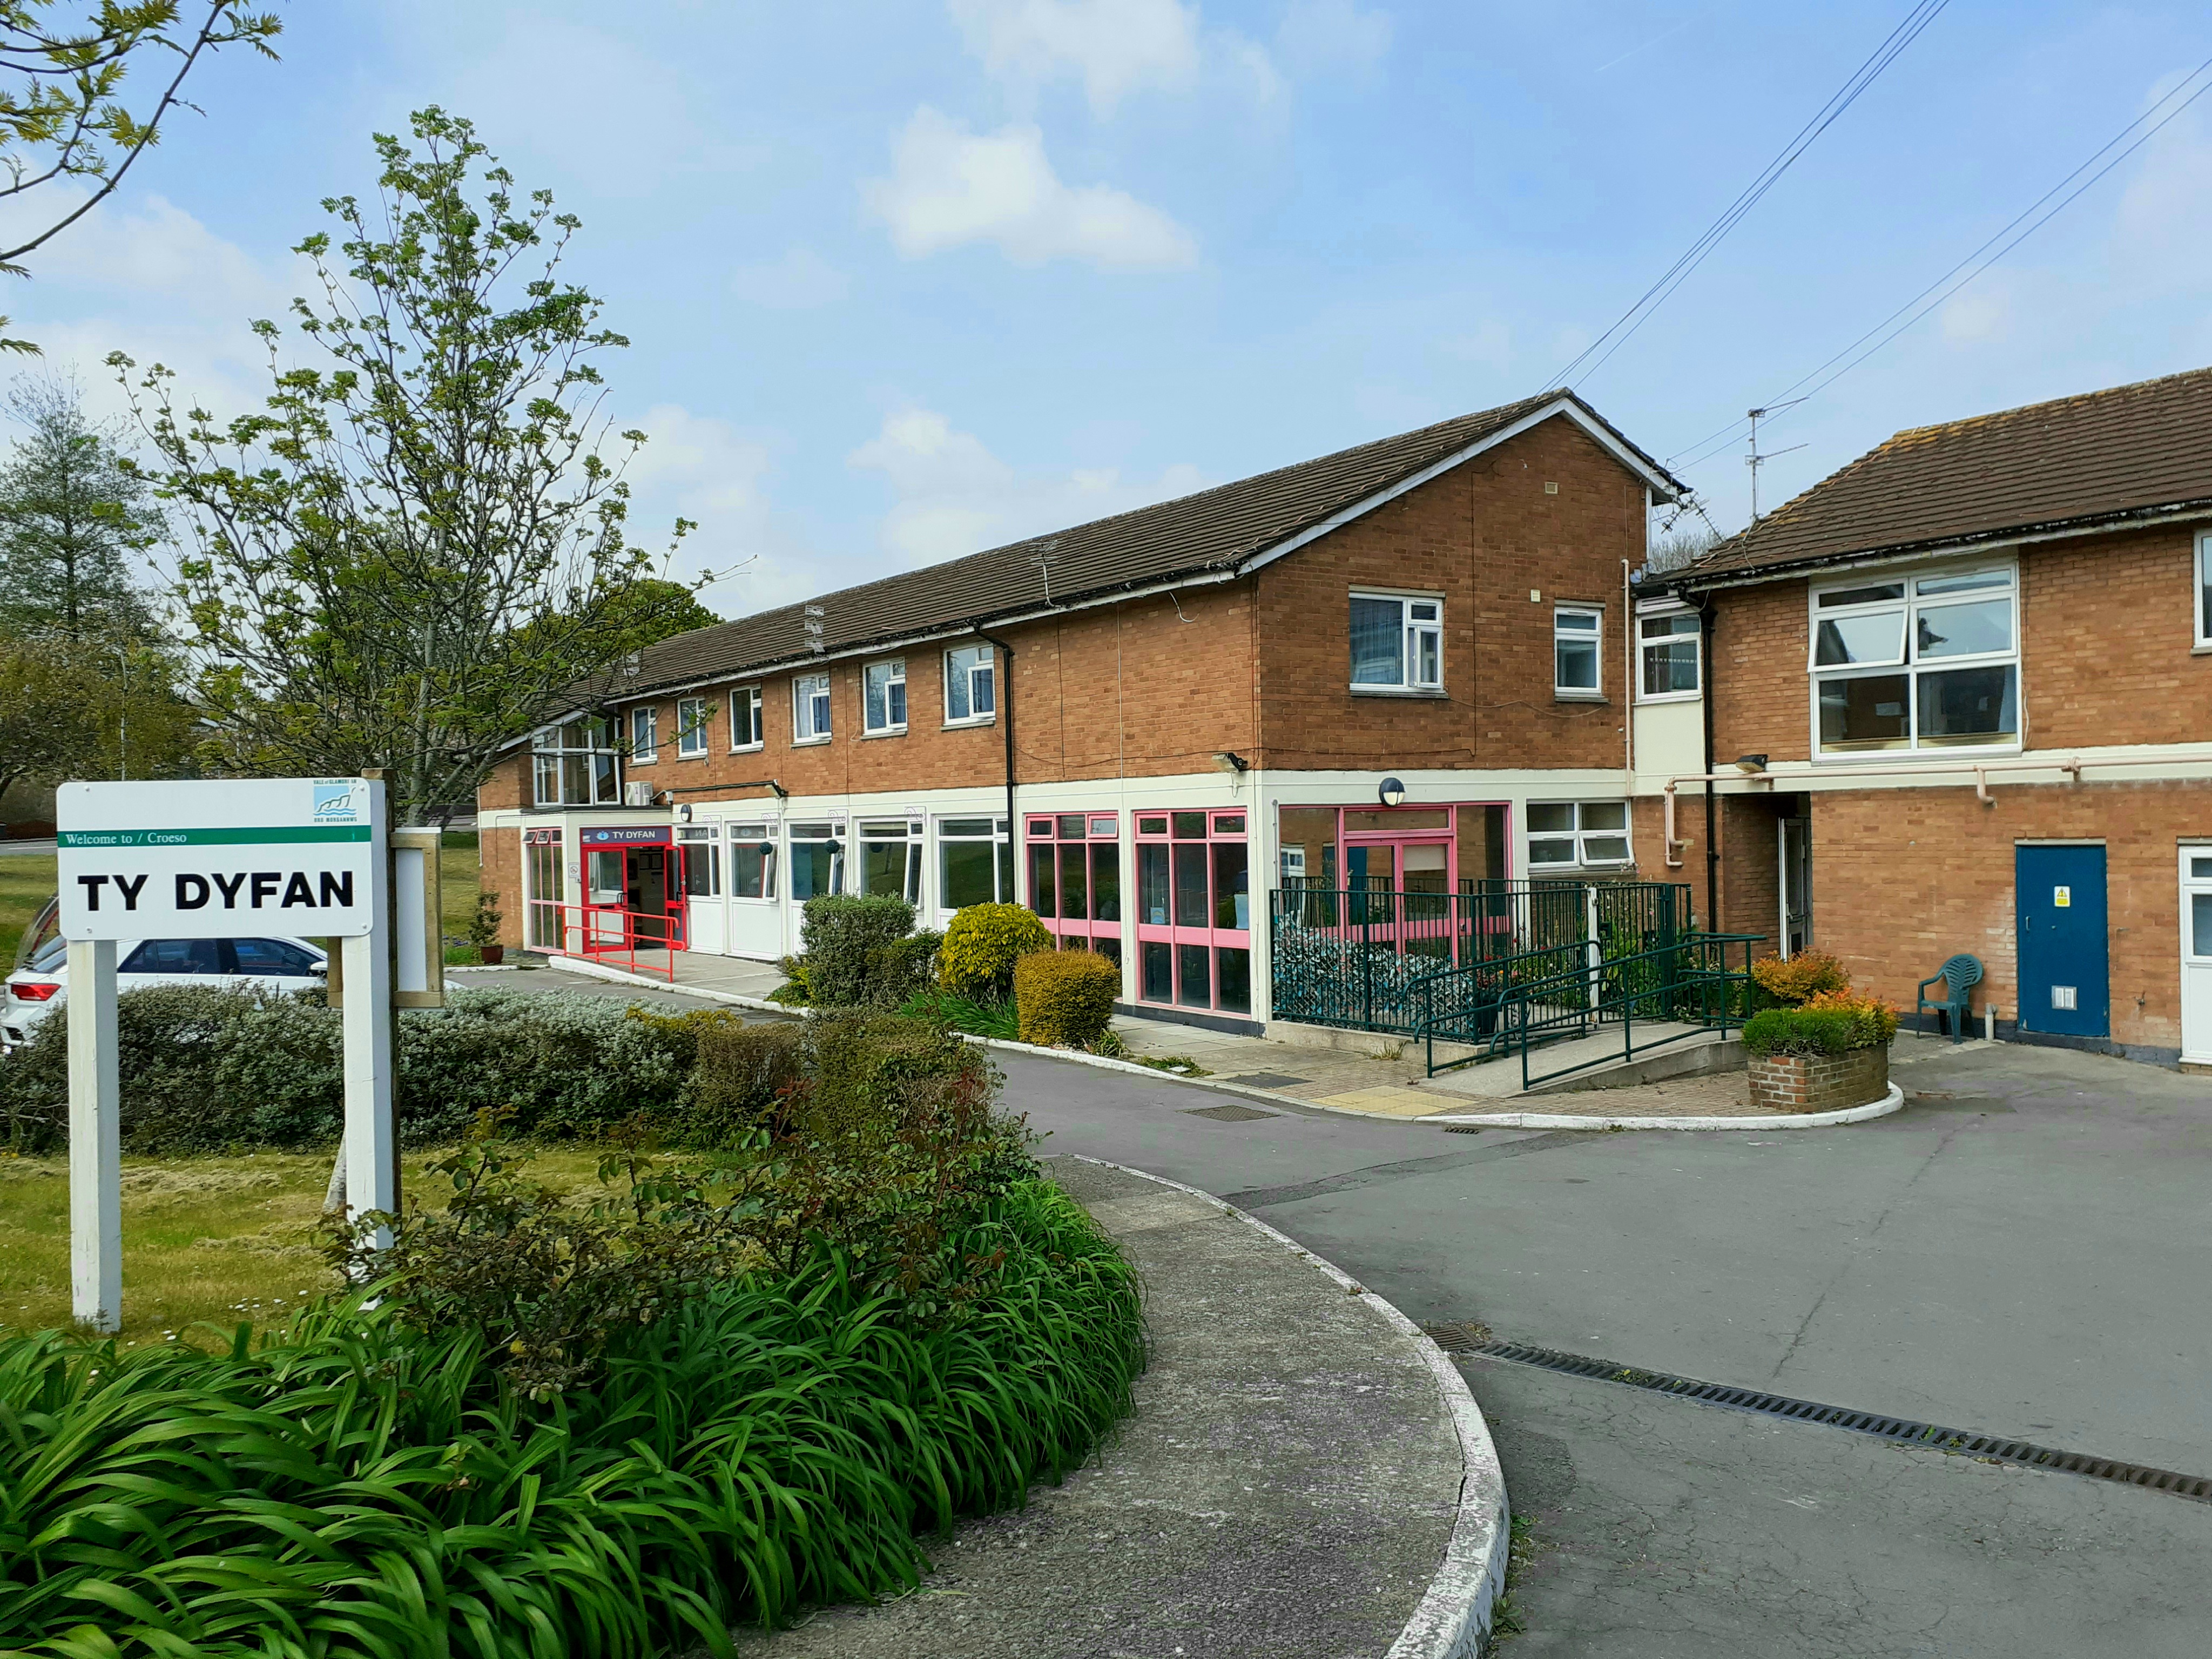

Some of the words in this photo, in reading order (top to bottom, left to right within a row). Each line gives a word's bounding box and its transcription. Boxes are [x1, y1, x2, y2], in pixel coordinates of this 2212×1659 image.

[65, 834, 117, 844] Welcome
[122, 834, 132, 844] to
[147, 832, 187, 843] Croeso
[626, 831, 655, 839] DYFAN
[78, 874, 149, 911] TY
[175, 871, 354, 911] DYFAN
